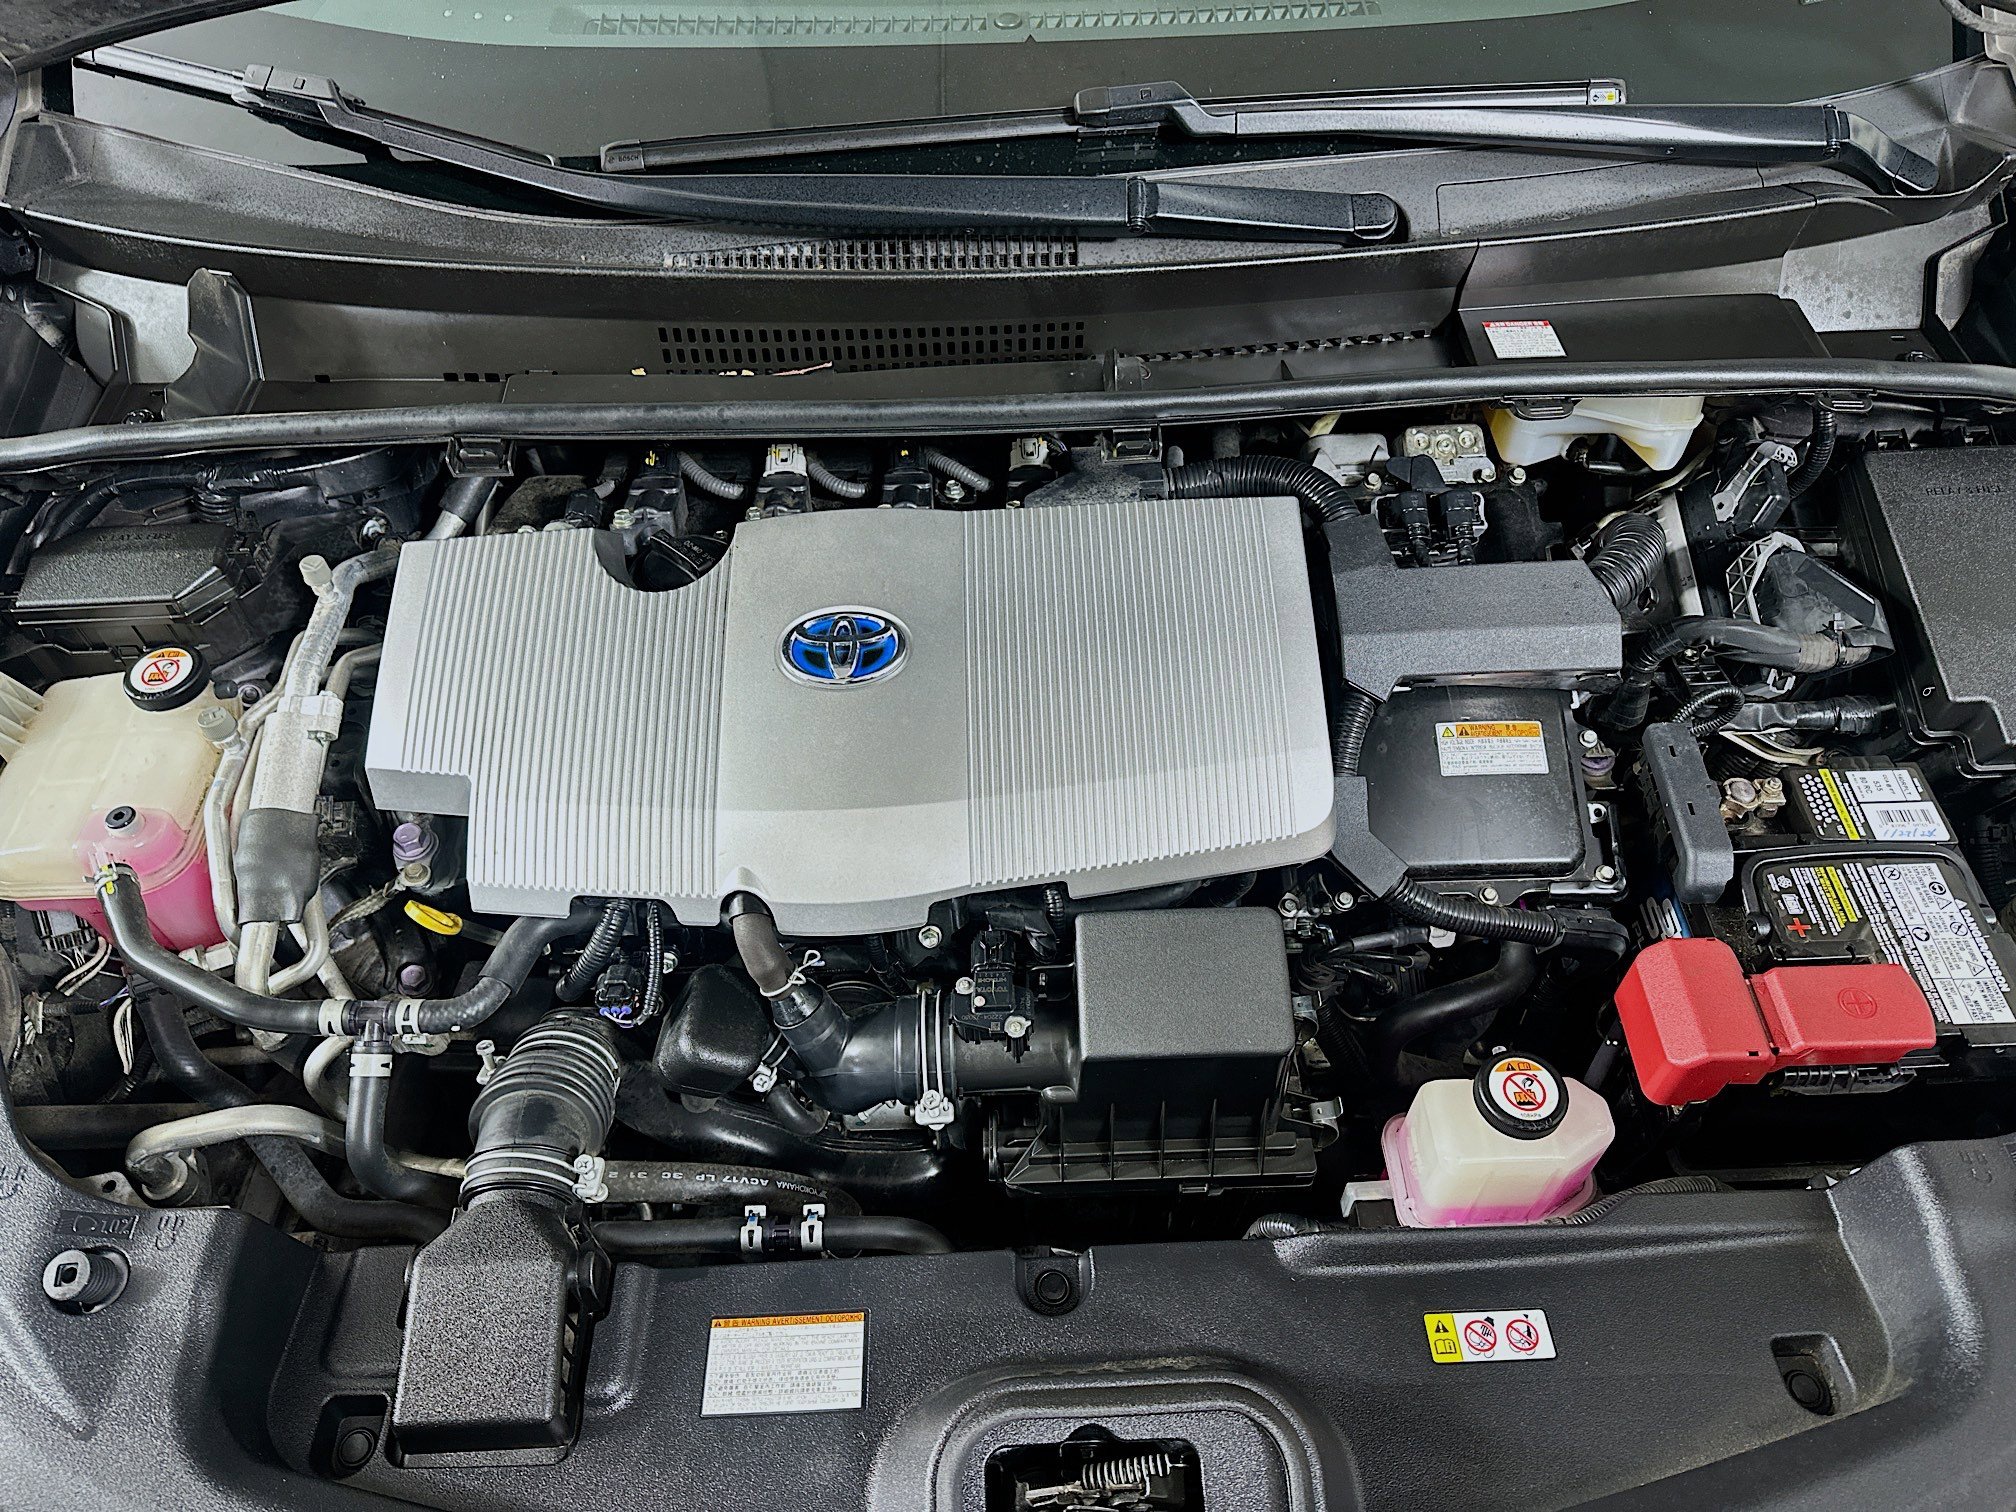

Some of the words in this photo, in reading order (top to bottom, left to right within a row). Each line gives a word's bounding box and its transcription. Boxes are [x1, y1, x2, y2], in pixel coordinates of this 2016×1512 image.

[618, 153, 639, 162] BOSCH
[1925, 486, 1961, 496] RELAY
[1864, 785, 1873, 793] RC
[1873, 780, 1884, 792] 535
[1918, 866, 1927, 876] EYES
[1925, 866, 1936, 879] SHIELD
[1912, 866, 1926, 888] EXPLOSIVE
[1924, 890, 1934, 903] GASES
[1956, 941, 1965, 951] ACID
[1960, 909, 2011, 992] DANGER/POISON
[1940, 981, 1948, 991] OPEN
[1946, 993, 1958, 1010] BATTERY
[1976, 981, 1984, 993] WITH
[1982, 995, 1994, 1010] WATER
[1984, 982, 2002, 1012] IMMEDIATELY
[1965, 996, 1974, 1007] HELP
[1971, 1009, 1980, 1020] FAST
[1997, 996, 2006, 1008] EYES
[1974, 1000, 1986, 1021] MEDICAL
[1985, 1012, 1994, 1021] GET
[629, 1171, 648, 1179] 31
[695, 1173, 715, 1182] LP
[722, 1175, 770, 1187] ACV17
[775, 1180, 819, 1195] YOKOHAMA
[741, 1317, 771, 1327] WARNING
[772, 1315, 823, 1325] AVERTISSEMENT
